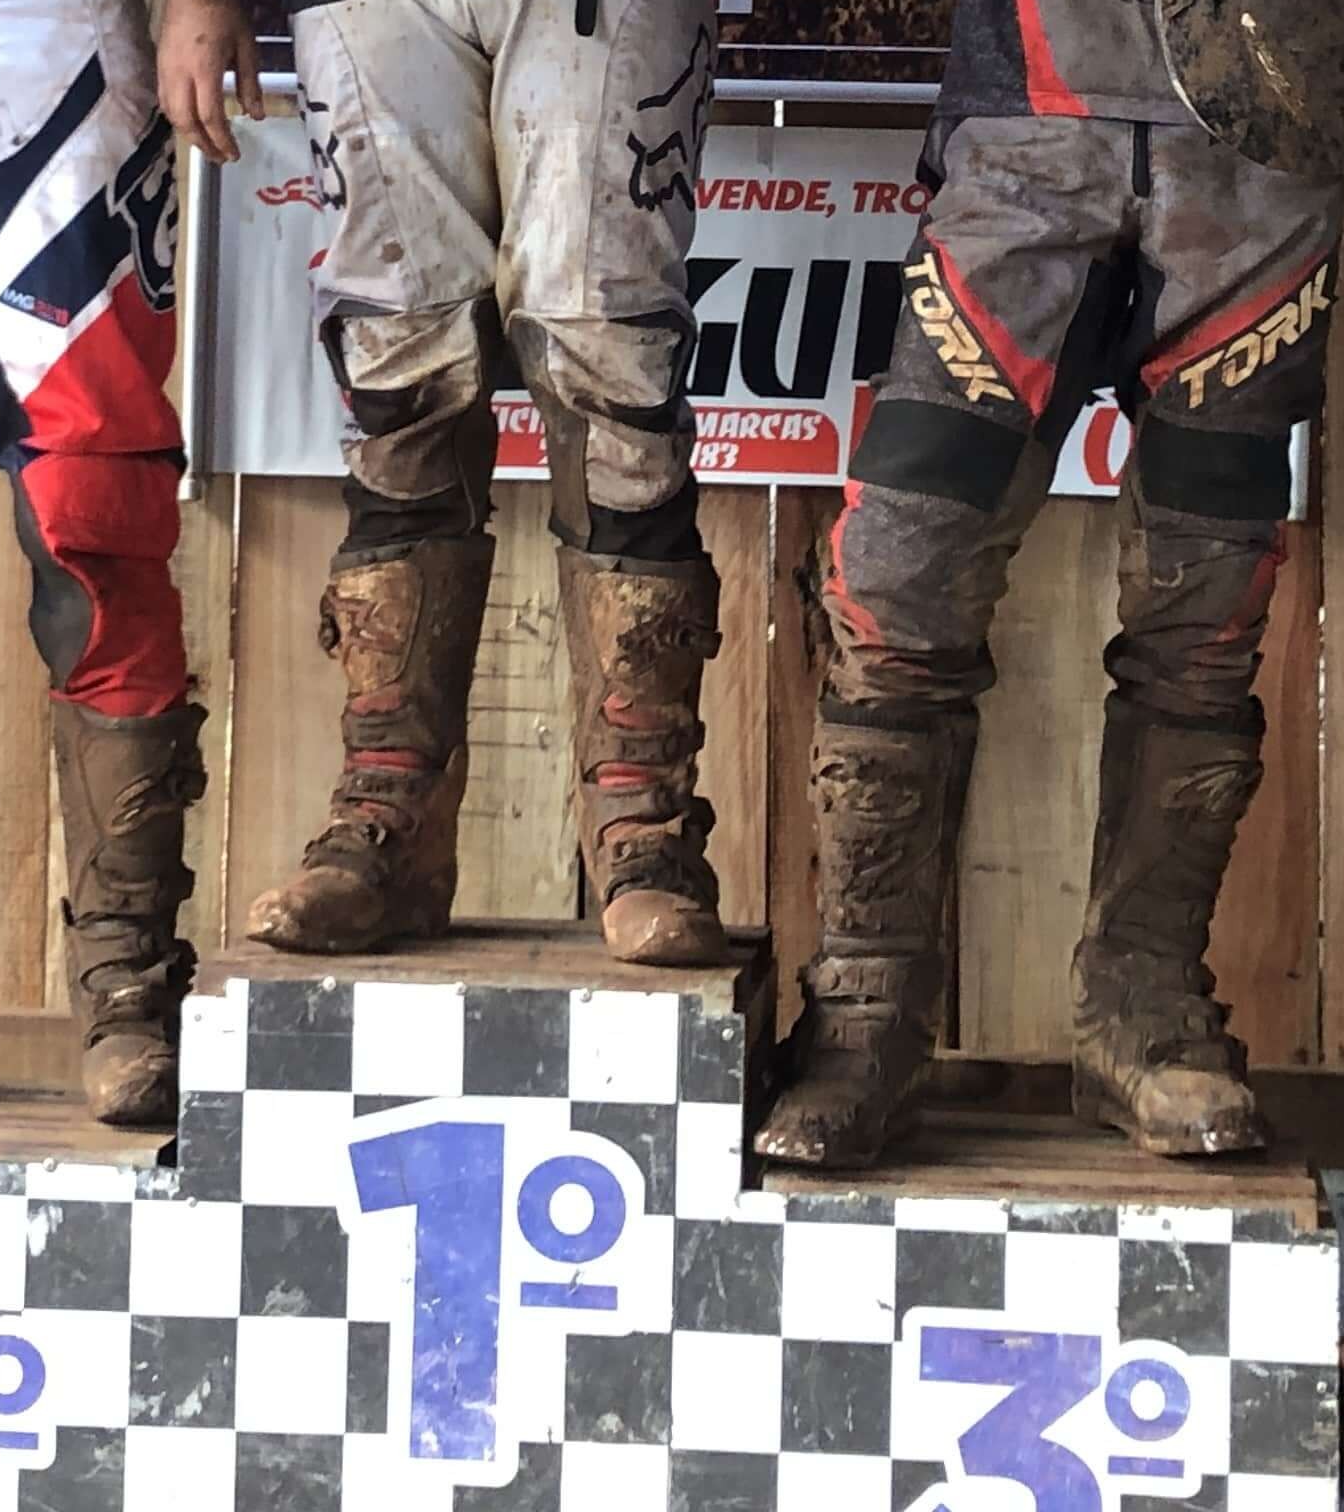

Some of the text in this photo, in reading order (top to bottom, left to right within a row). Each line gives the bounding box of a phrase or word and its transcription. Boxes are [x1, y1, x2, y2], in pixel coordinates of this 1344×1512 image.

[853, 181, 935, 215] TRO
[902, 251, 1015, 403] TORK
[1179, 263, 1332, 409] TORK
